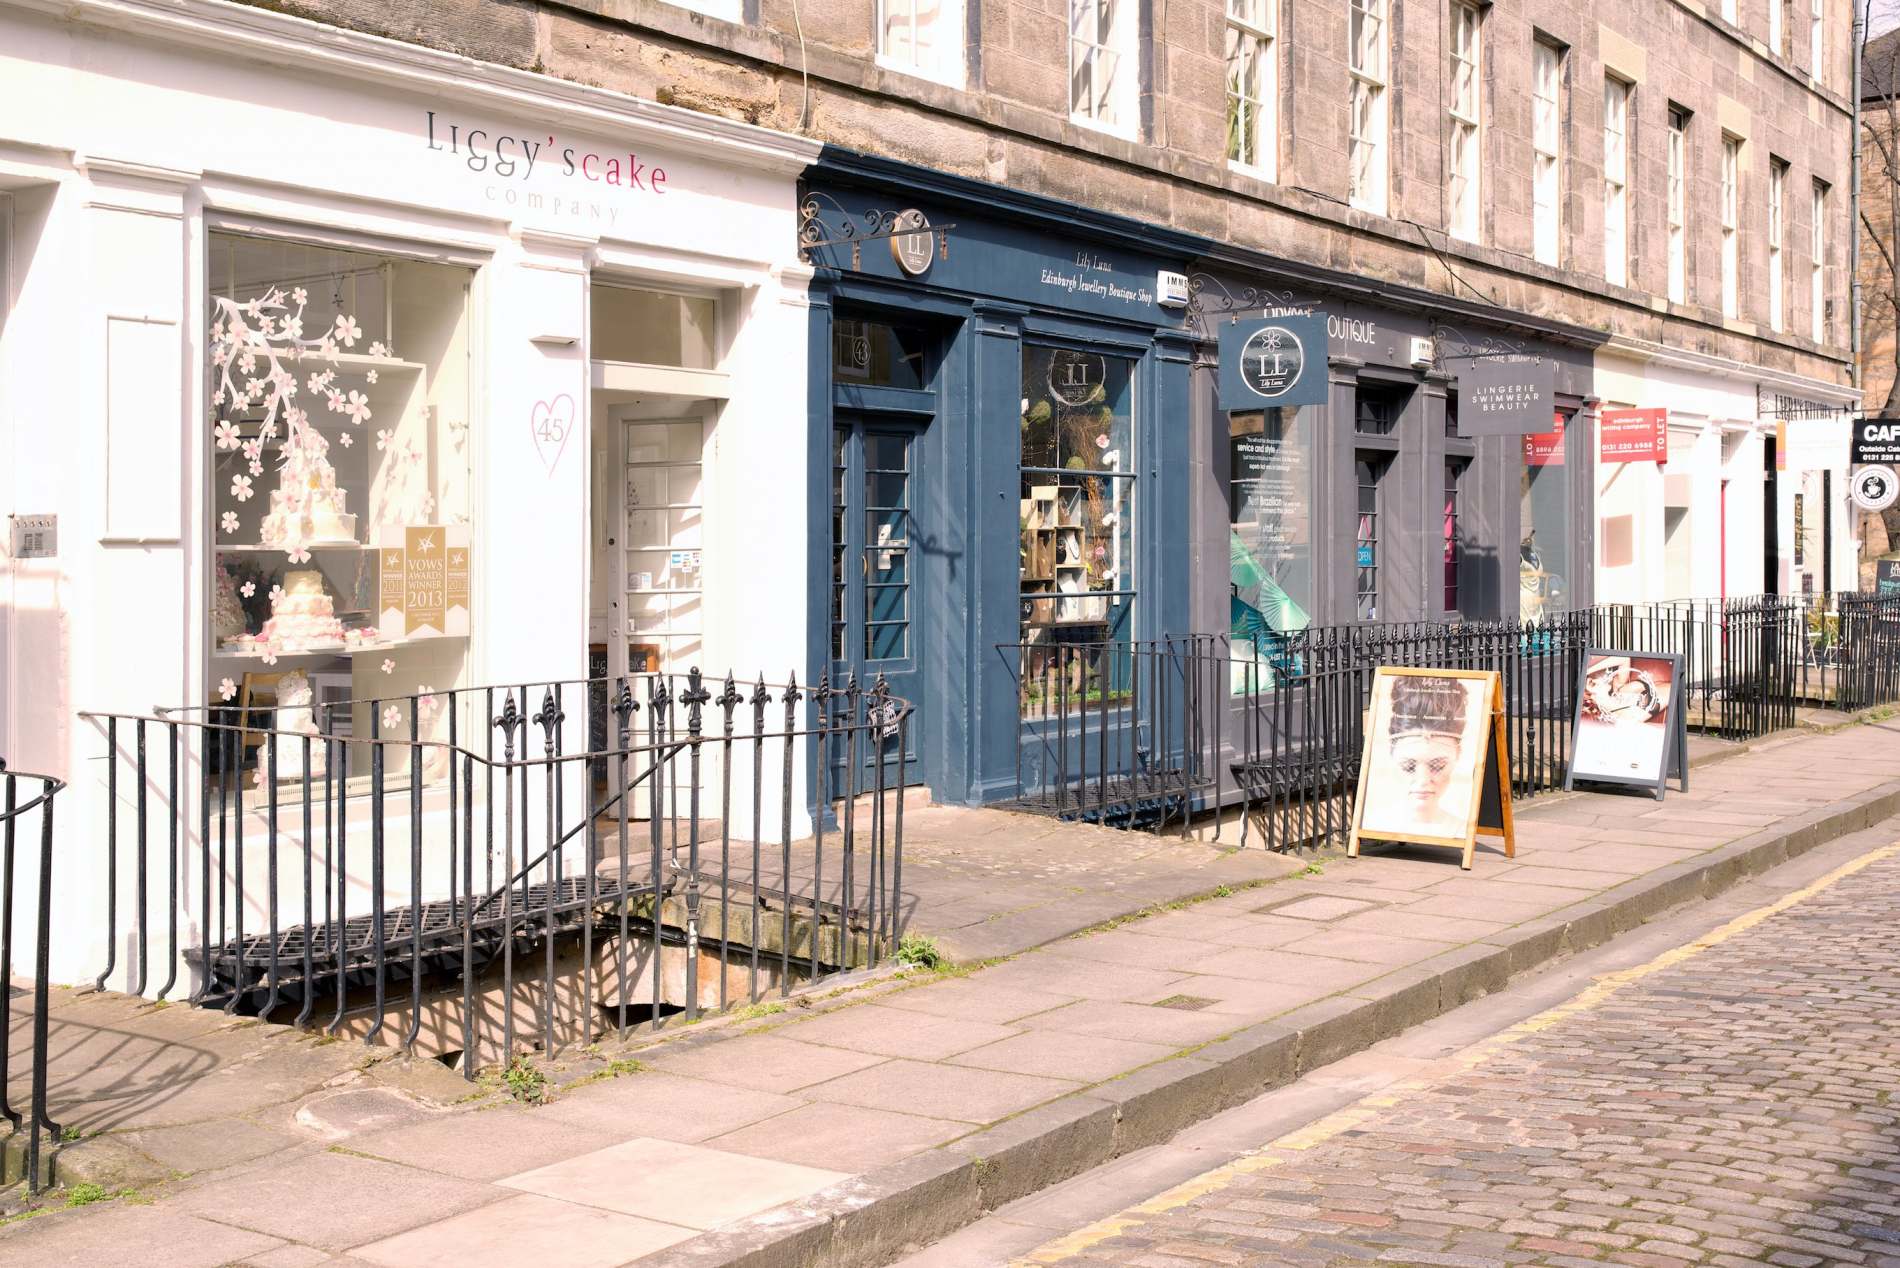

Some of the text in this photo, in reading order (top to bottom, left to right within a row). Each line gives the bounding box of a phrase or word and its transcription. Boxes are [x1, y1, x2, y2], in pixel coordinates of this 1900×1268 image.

[1075, 251, 1112, 272] Lily Luna
[1040, 269, 1153, 307] Edinburgh Jewellery Boutique Shop
[1327, 314, 1376, 345] OUTIQUE
[1258, 353, 1288, 377] LL
[1476, 384, 1536, 395] LINGERIE
[1471, 393, 1541, 404] SWIMWEAR
[1482, 402, 1529, 411] BEAUTY
[537, 418, 564, 442] 45
[1656, 417, 1665, 451] TO LET
[1863, 424, 1900, 442] CAF
[408, 559, 443, 571] VOWS
[408, 571, 442, 580] AWARDS
[408, 580, 442, 590] WINNER
[408, 591, 443, 608] 2013
